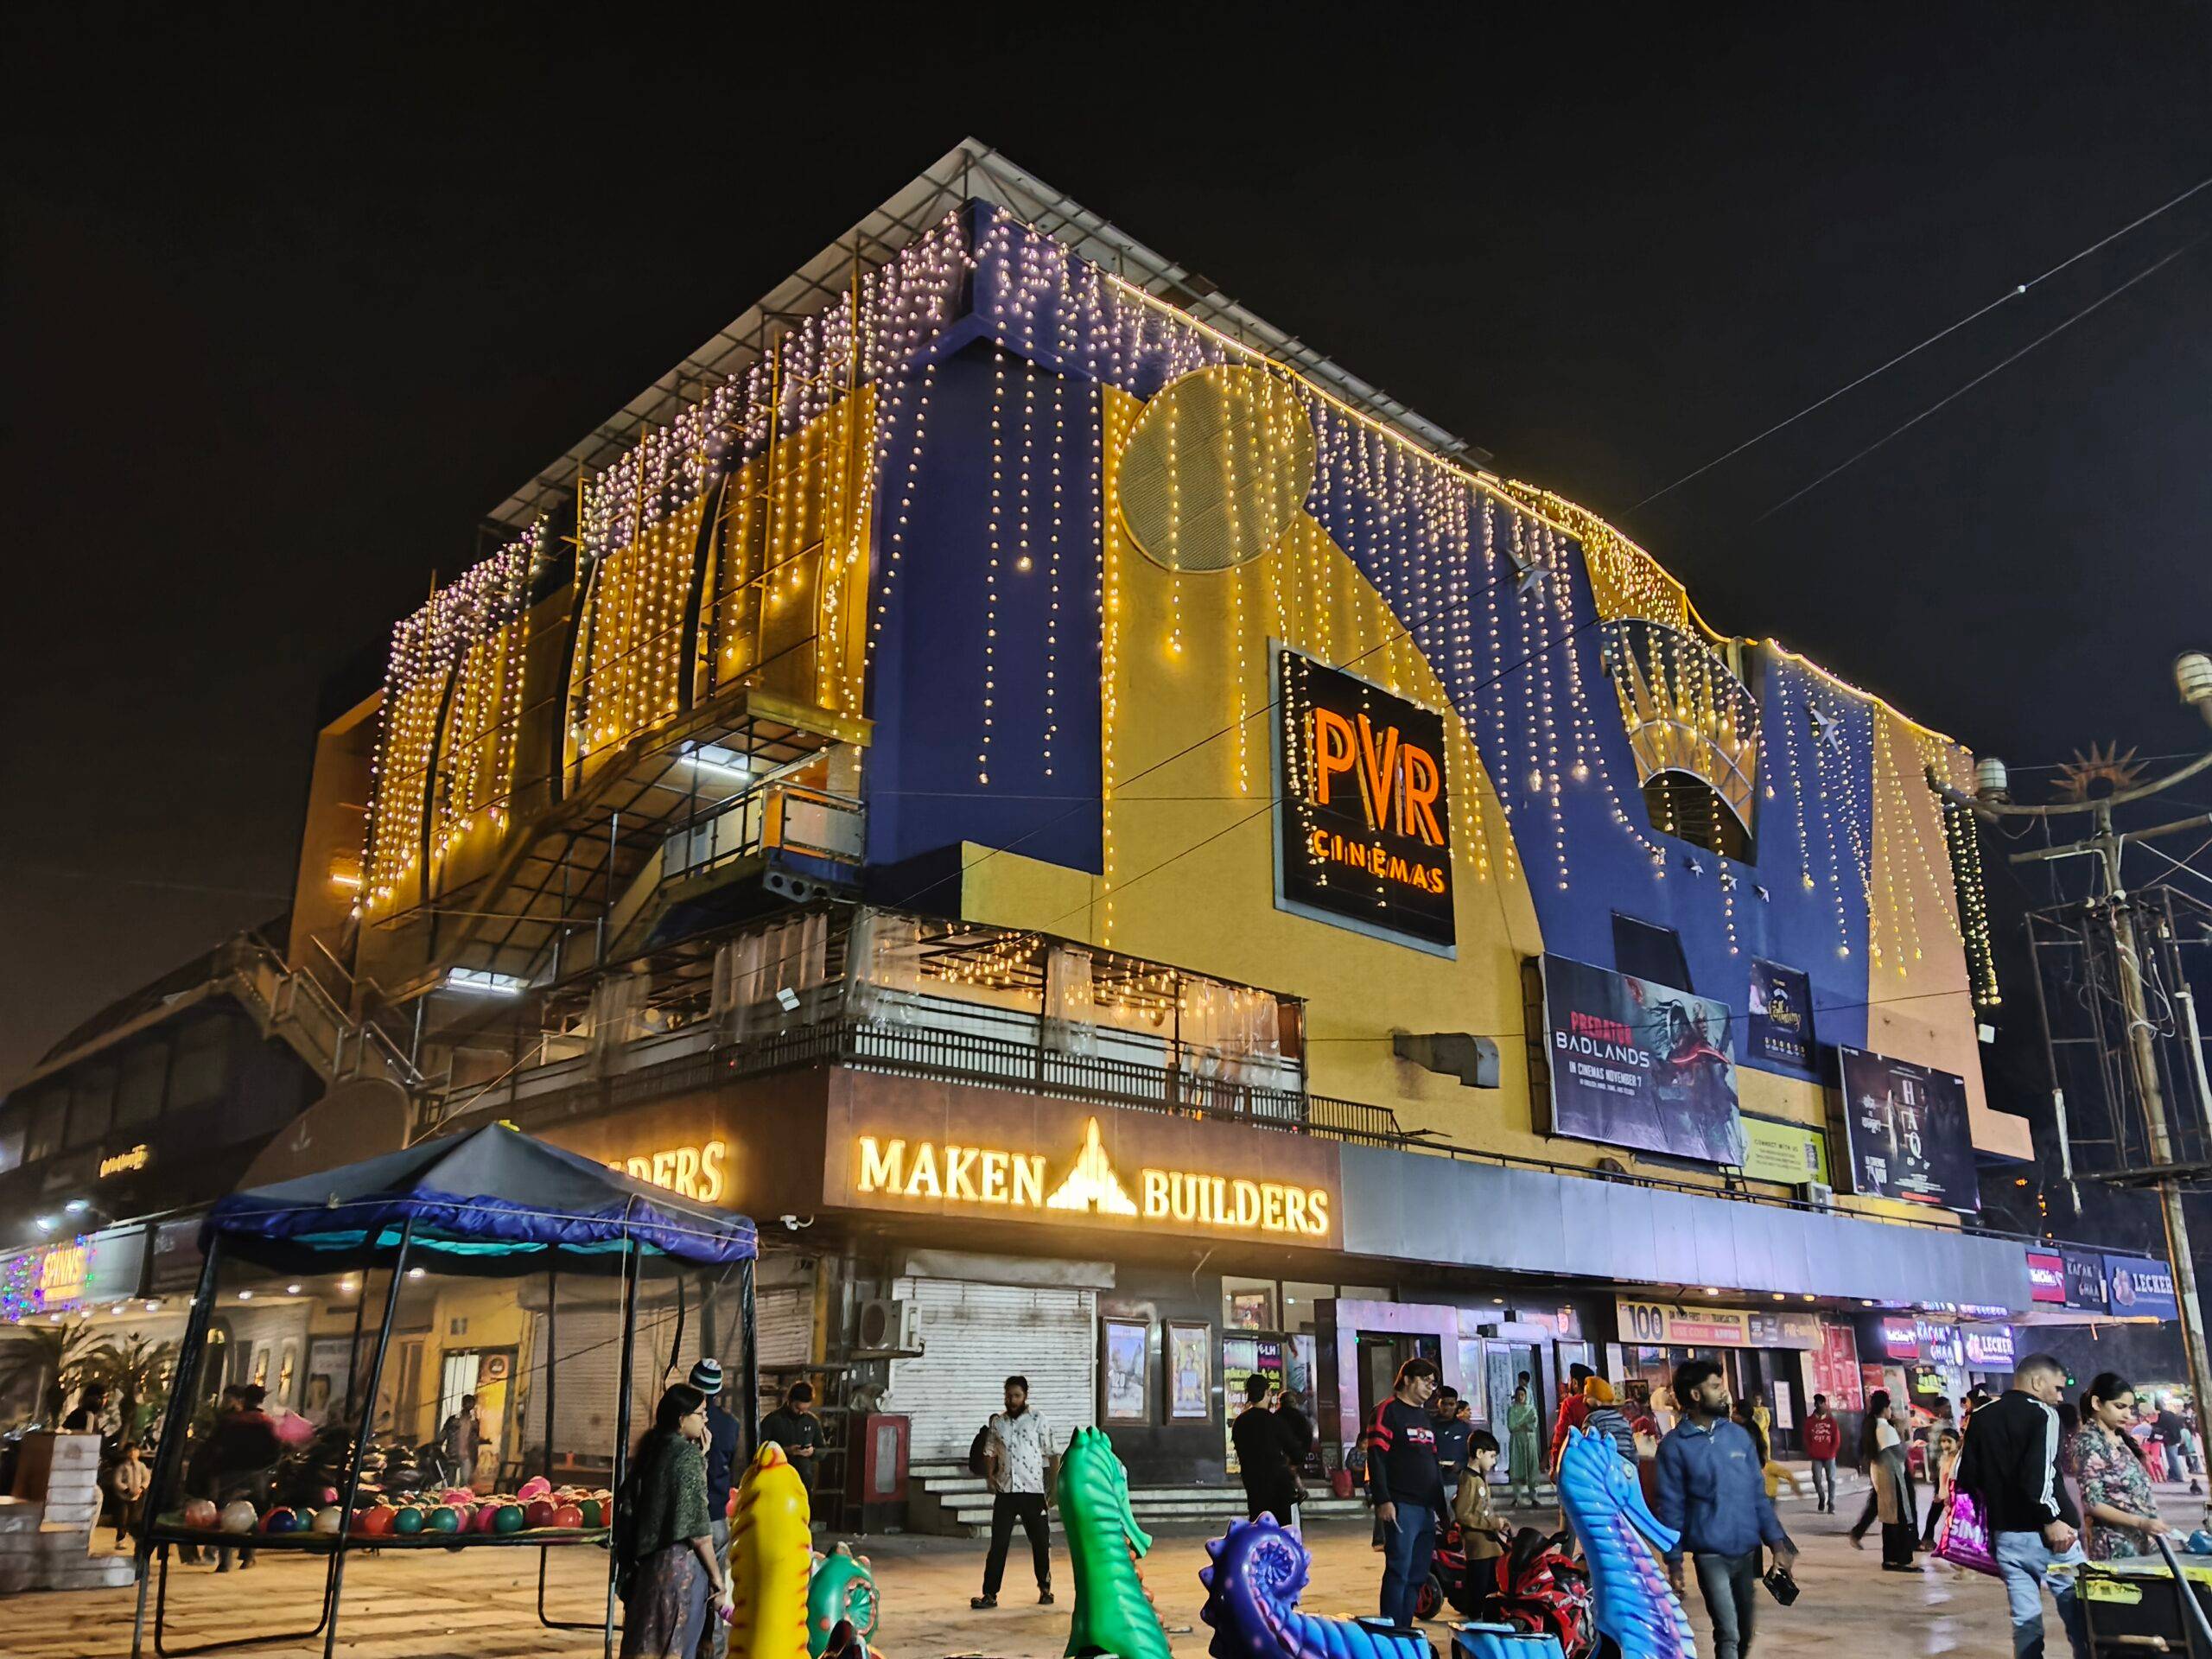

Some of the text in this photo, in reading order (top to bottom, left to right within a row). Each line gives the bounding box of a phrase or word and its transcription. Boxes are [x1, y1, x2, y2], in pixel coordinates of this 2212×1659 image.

[1306, 707, 1445, 846] PVR
[1313, 830, 1446, 893] CINEMAS
[1570, 1011, 1632, 1046] PREDATOR
[1556, 1031, 1649, 1068] BADLANDS
[1569, 1061, 1577, 1073] IN
[1578, 1062, 1605, 1080] CINEMAS
[1605, 1069, 1637, 1087] NOVEMBER
[1637, 1076, 1642, 1087] 7
[608, 1141, 725, 1203] DERS
[857, 1136, 1329, 1236] MAKEN BUILDERS
[2133, 1274, 2174, 1294] LECKER
[1981, 1336, 2014, 1355] LECKER
